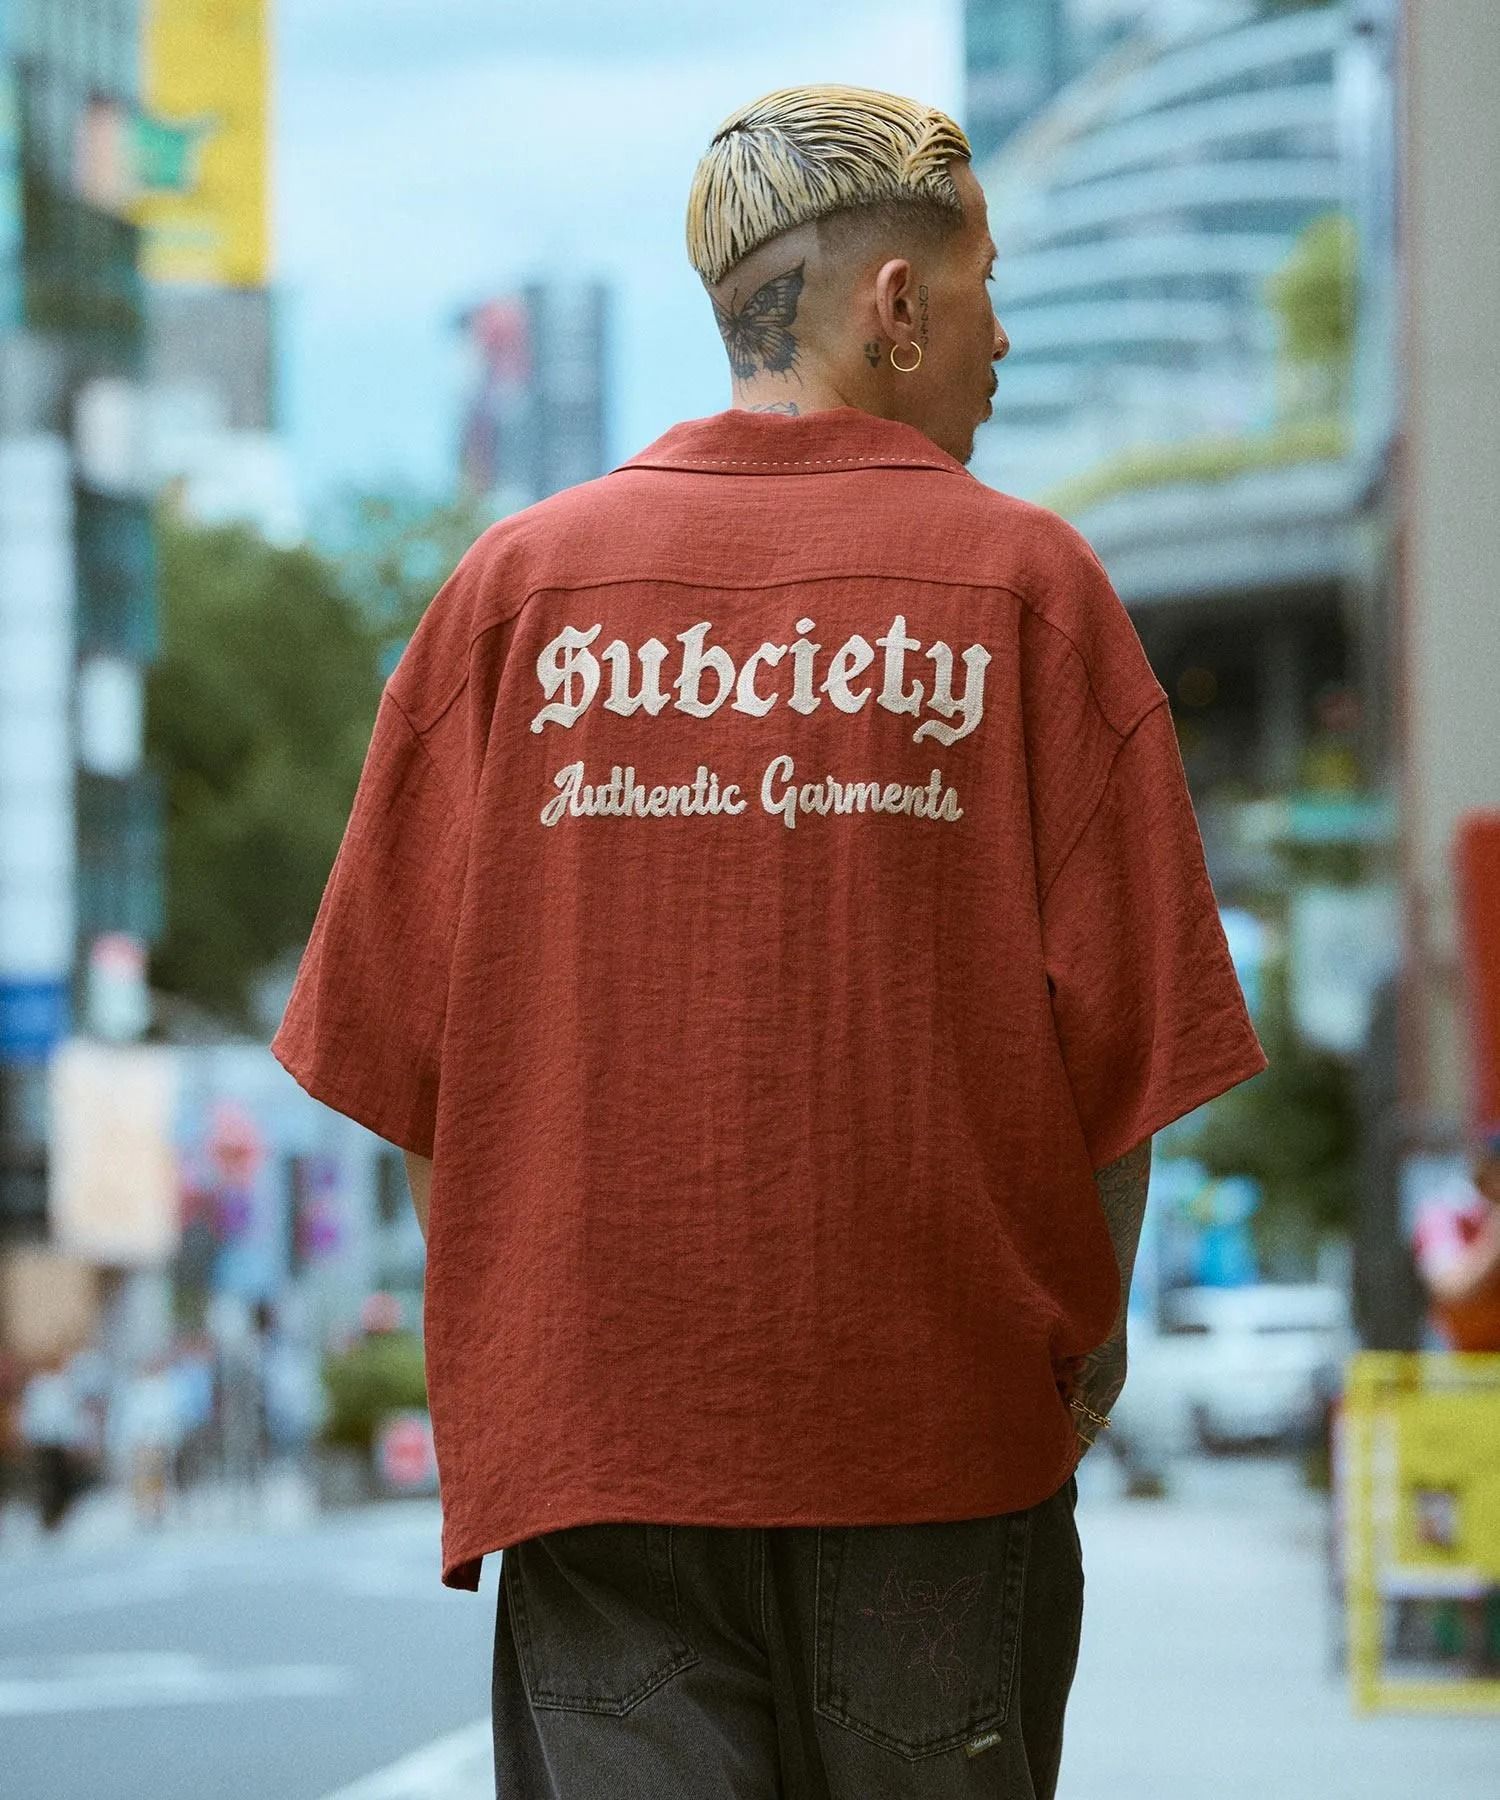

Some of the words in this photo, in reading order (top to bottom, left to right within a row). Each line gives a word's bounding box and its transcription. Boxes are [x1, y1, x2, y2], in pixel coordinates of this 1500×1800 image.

[530, 615, 992, 746] Subciety
[540, 760, 748, 828] Authentic
[760, 754, 964, 830] Garments
